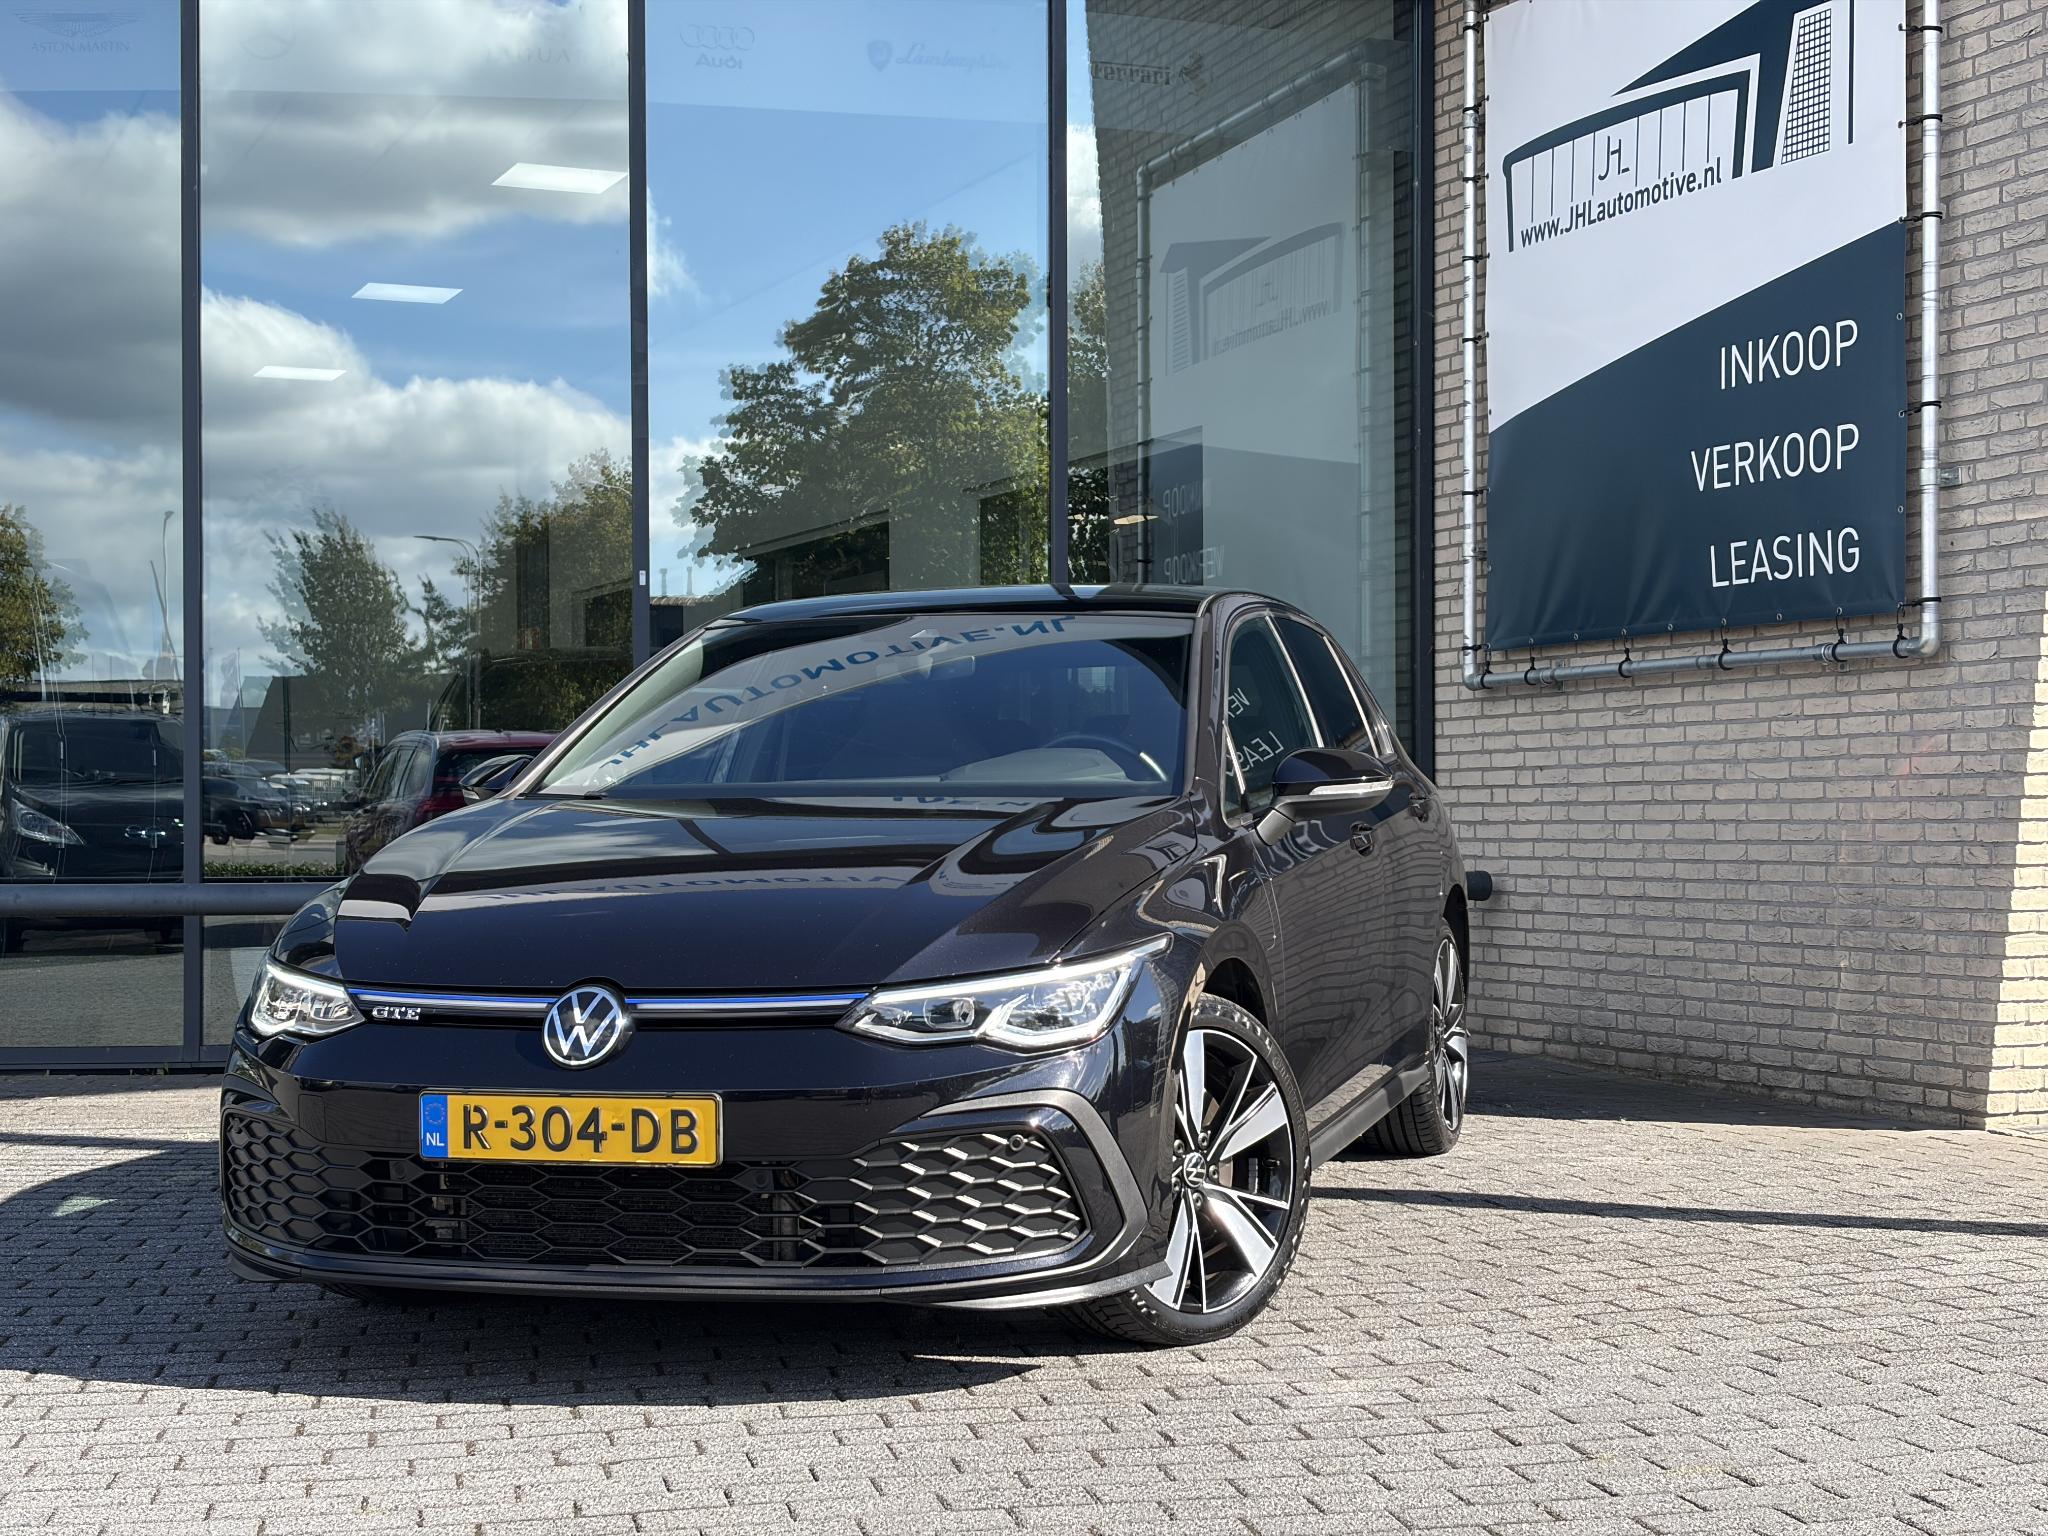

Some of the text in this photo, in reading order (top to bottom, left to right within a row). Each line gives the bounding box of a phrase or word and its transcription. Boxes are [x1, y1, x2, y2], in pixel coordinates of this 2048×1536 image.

[1520, 156, 1722, 248] www.JHLautomotive.nl
[1720, 319, 1858, 390] INKOOP
[1690, 423, 1860, 492] VERKOOP
[1710, 526, 1860, 588] LEASING
[372, 1005, 421, 1021] GTE
[425, 1131, 445, 1147] NL
[463, 1103, 700, 1155] R-304-DB
